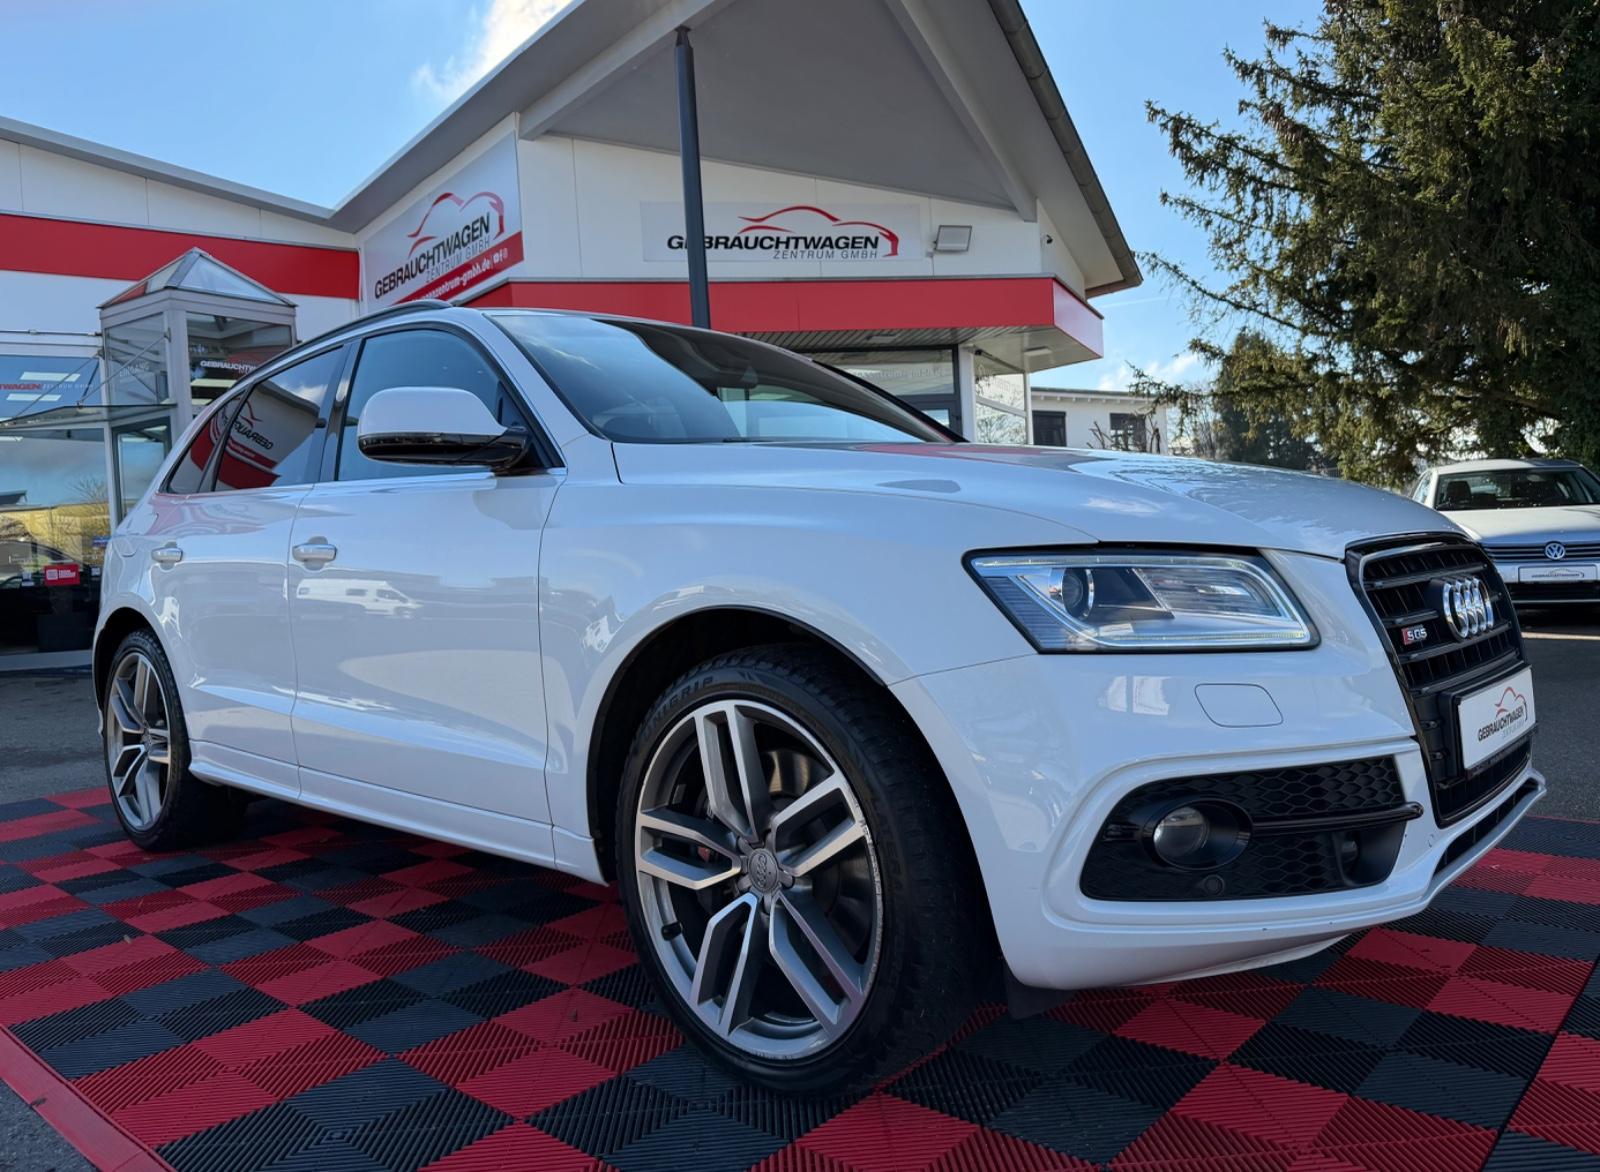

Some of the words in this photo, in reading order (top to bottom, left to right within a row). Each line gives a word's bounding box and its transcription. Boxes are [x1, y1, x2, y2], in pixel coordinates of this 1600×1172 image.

[374, 212, 491, 299] GEBRAUCHTWAGEN
[667, 235, 879, 250] GBRAUCHTWAGEN
[773, 250, 835, 259] ZENTRUM
[841, 250, 877, 259] GMBH
[426, 252, 462, 283] ZENTRUM
[465, 237, 490, 261] GMBH
